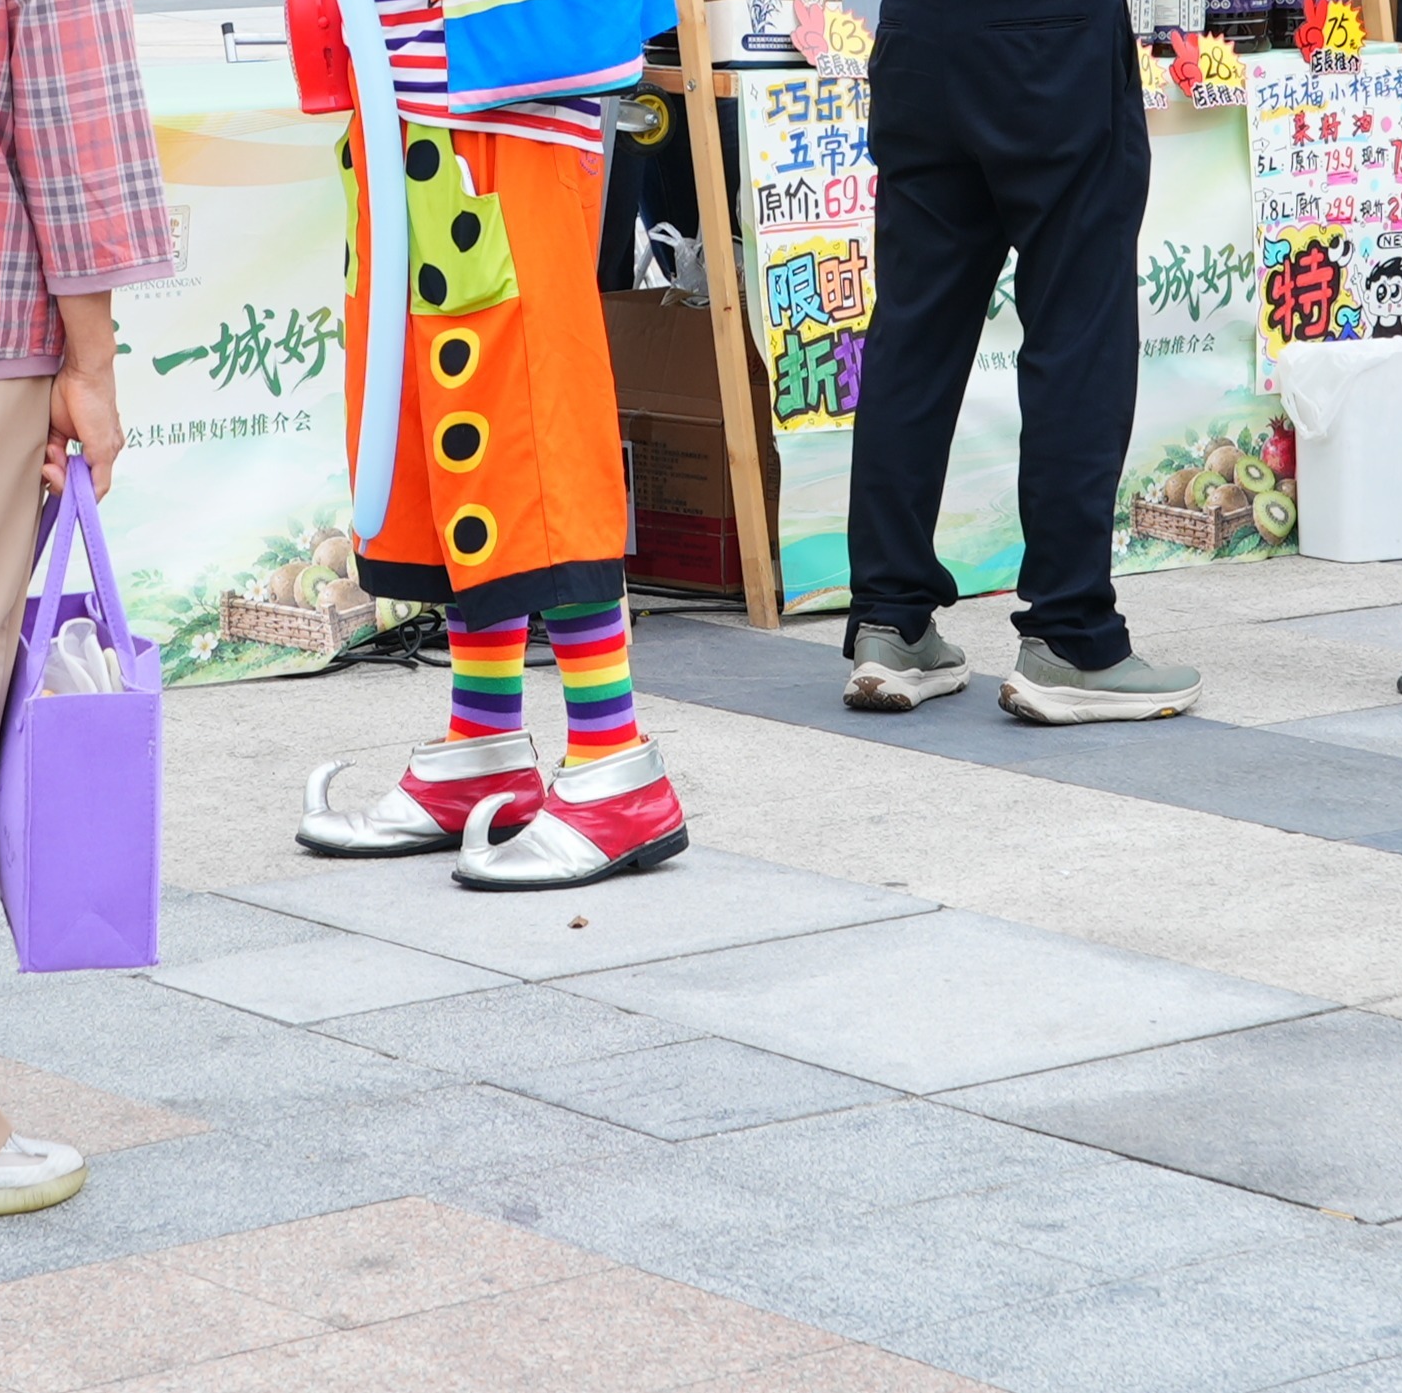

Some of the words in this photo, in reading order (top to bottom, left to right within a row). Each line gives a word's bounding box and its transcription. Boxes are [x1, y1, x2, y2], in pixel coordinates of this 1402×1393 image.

[829, 18, 866, 55] 63
[817, 53, 869, 77] 店長推
[1292, 110, 1373, 147] 菜籽油
[766, 238, 868, 329] 限时
[1138, 240, 1255, 322] 城好
[1267, 240, 1362, 343] 特
[152, 303, 345, 397] 一城好
[1139, 333, 1215, 358] 好物推介会
[126, 410, 312, 449] 公共品牌好物推介会
